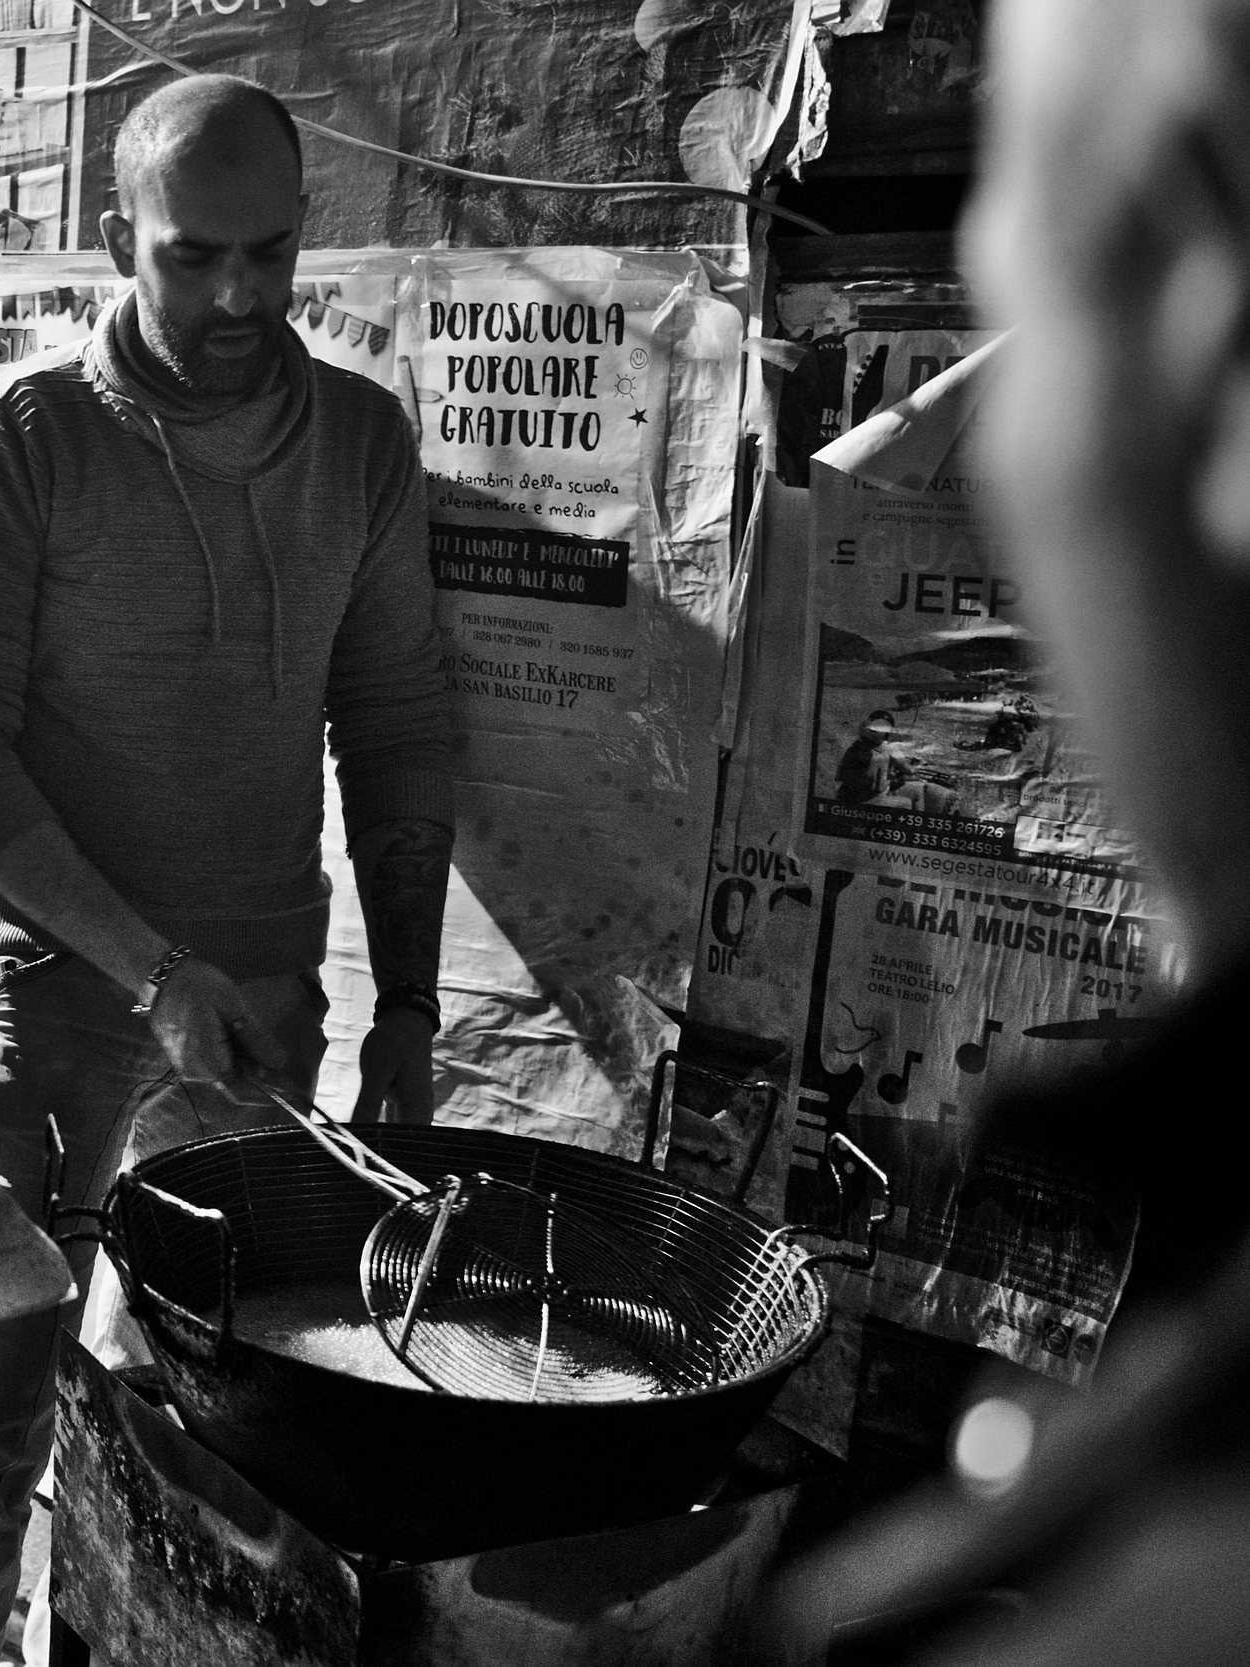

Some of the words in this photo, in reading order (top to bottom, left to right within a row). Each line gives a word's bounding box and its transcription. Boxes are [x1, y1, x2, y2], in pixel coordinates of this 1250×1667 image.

[430, 301, 624, 346] DOPOSCUOLA
[447, 355, 599, 399] POPOLARE
[441, 405, 601, 451] GRATUITO
[455, 471, 513, 489] bambini
[519, 473, 562, 490] della
[569, 478, 619, 494] scuola
[439, 492, 526, 513] elementare
[534, 503, 543, 515] e
[550, 502, 596, 518] media
[461, 613, 480, 625] PER
[462, 678, 489, 696] SAN
[494, 682, 551, 705] BASILIO
[556, 689, 579, 709] 17
[831, 804, 892, 824] Giuseppe
[926, 817, 952, 832] 335
[870, 827, 907, 844] (+39)
[912, 832, 938, 847] 333
[941, 837, 1001, 857] 6324595
[869, 846, 1096, 896] www.segestatour4x4.it
[875, 897, 959, 938] GARA
[973, 915, 1147, 975] MUSICALE
[871, 953, 888, 966] 28
[889, 957, 932, 976] APRILE
[867, 982, 894, 998] ORE
[870, 968, 918, 988] TEATRO
[920, 977, 955, 995] LELIO
[1080, 975, 1143, 1004] 2017
